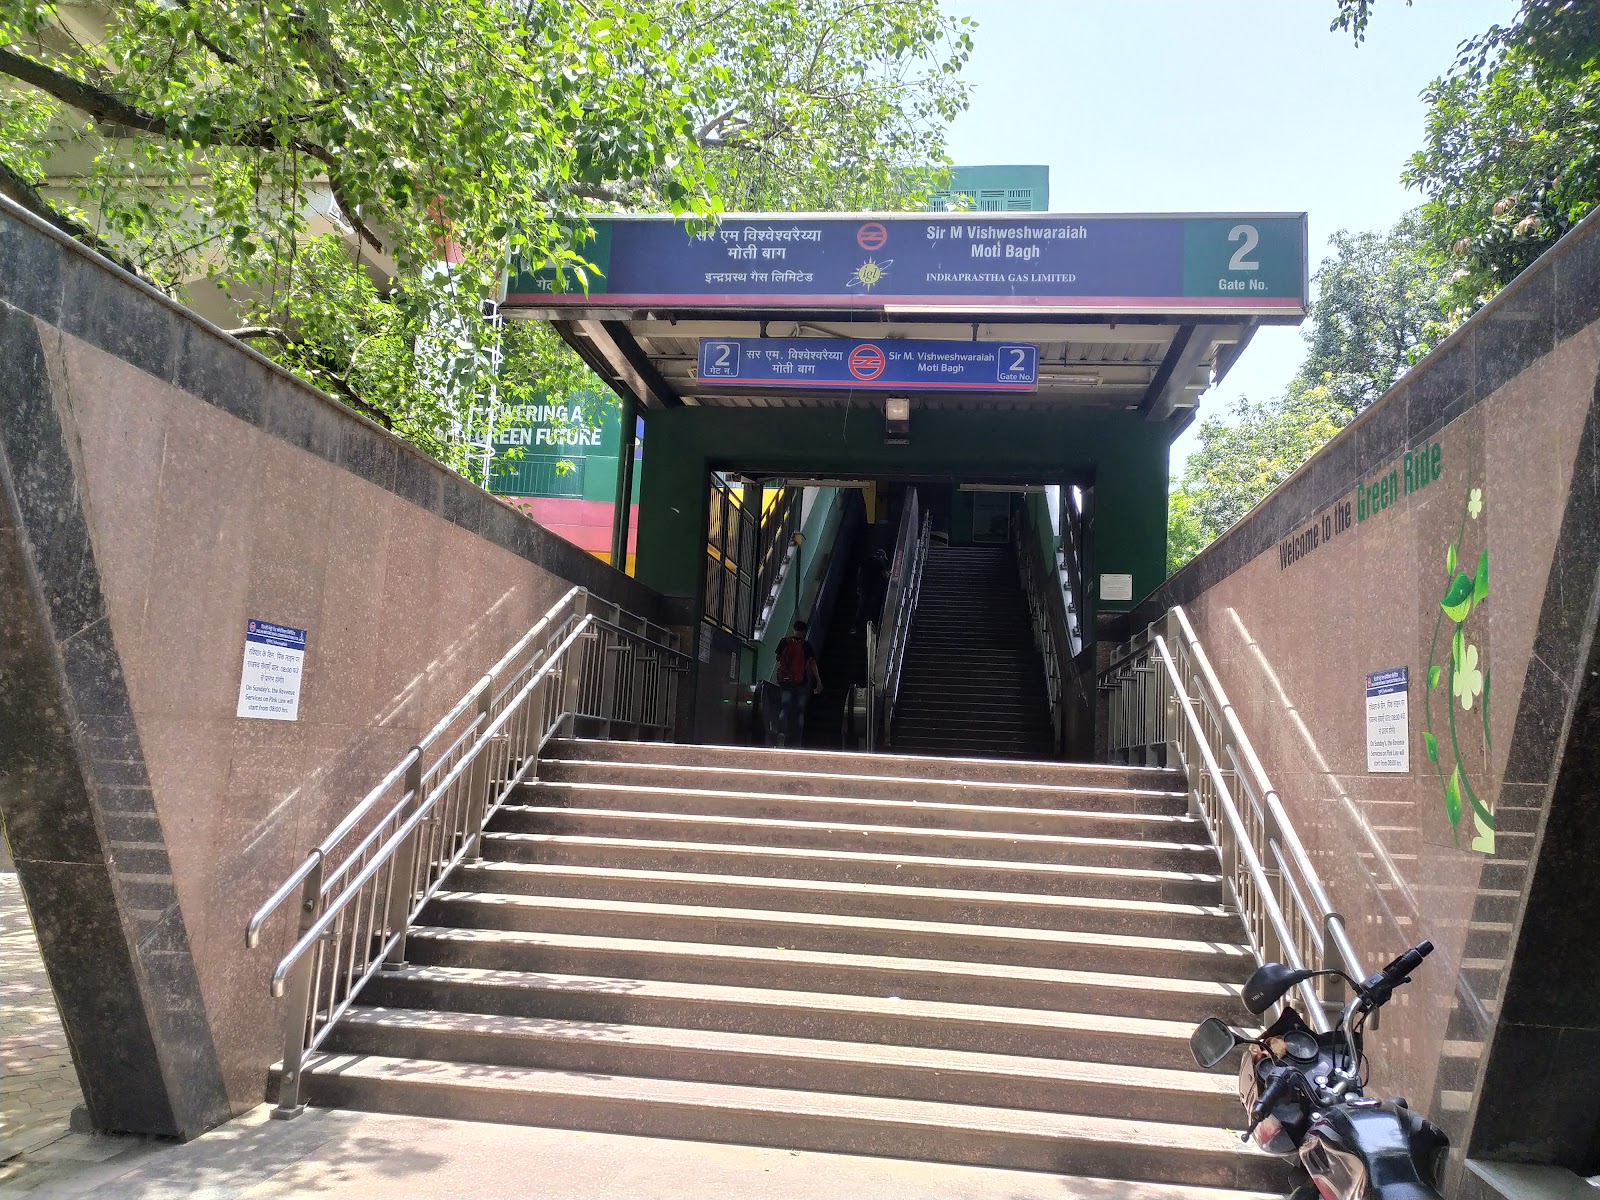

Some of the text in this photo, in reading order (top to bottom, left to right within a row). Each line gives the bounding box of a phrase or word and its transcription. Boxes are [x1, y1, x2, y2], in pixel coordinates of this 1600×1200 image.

[696, 226, 822, 243] सर एम विश्वेश्वरैय्या
[926, 225, 1088, 240] Sir M Vishweshwaraiah
[727, 243, 787, 260] मोती बाग
[971, 244, 1040, 261] Moti Bagh
[1227, 224, 1260, 271] 2
[704, 269, 814, 283] इन्द्रप्रस्थ गैस लिमिटेड
[925, 272, 1077, 283] INDRAPRASTHA GAS LIMITED
[1218, 278, 1269, 292] Gate No.
[714, 344, 730, 367] 2
[746, 350, 762, 360] सर
[888, 351, 995, 362] Sir M. Vishweshwaraiah
[1009, 348, 1026, 372] 2
[709, 365, 721, 375] गेट
[772, 361, 794, 375] मोती
[917, 362, 964, 375] Moti Bagh
[999, 372, 1032, 381] Gate No.
[477, 404, 584, 422] WERING A
[535, 428, 602, 446] FUTURE
[1279, 439, 1441, 571] Welcome to the Green Ride
[245, 693, 263, 702] Services
